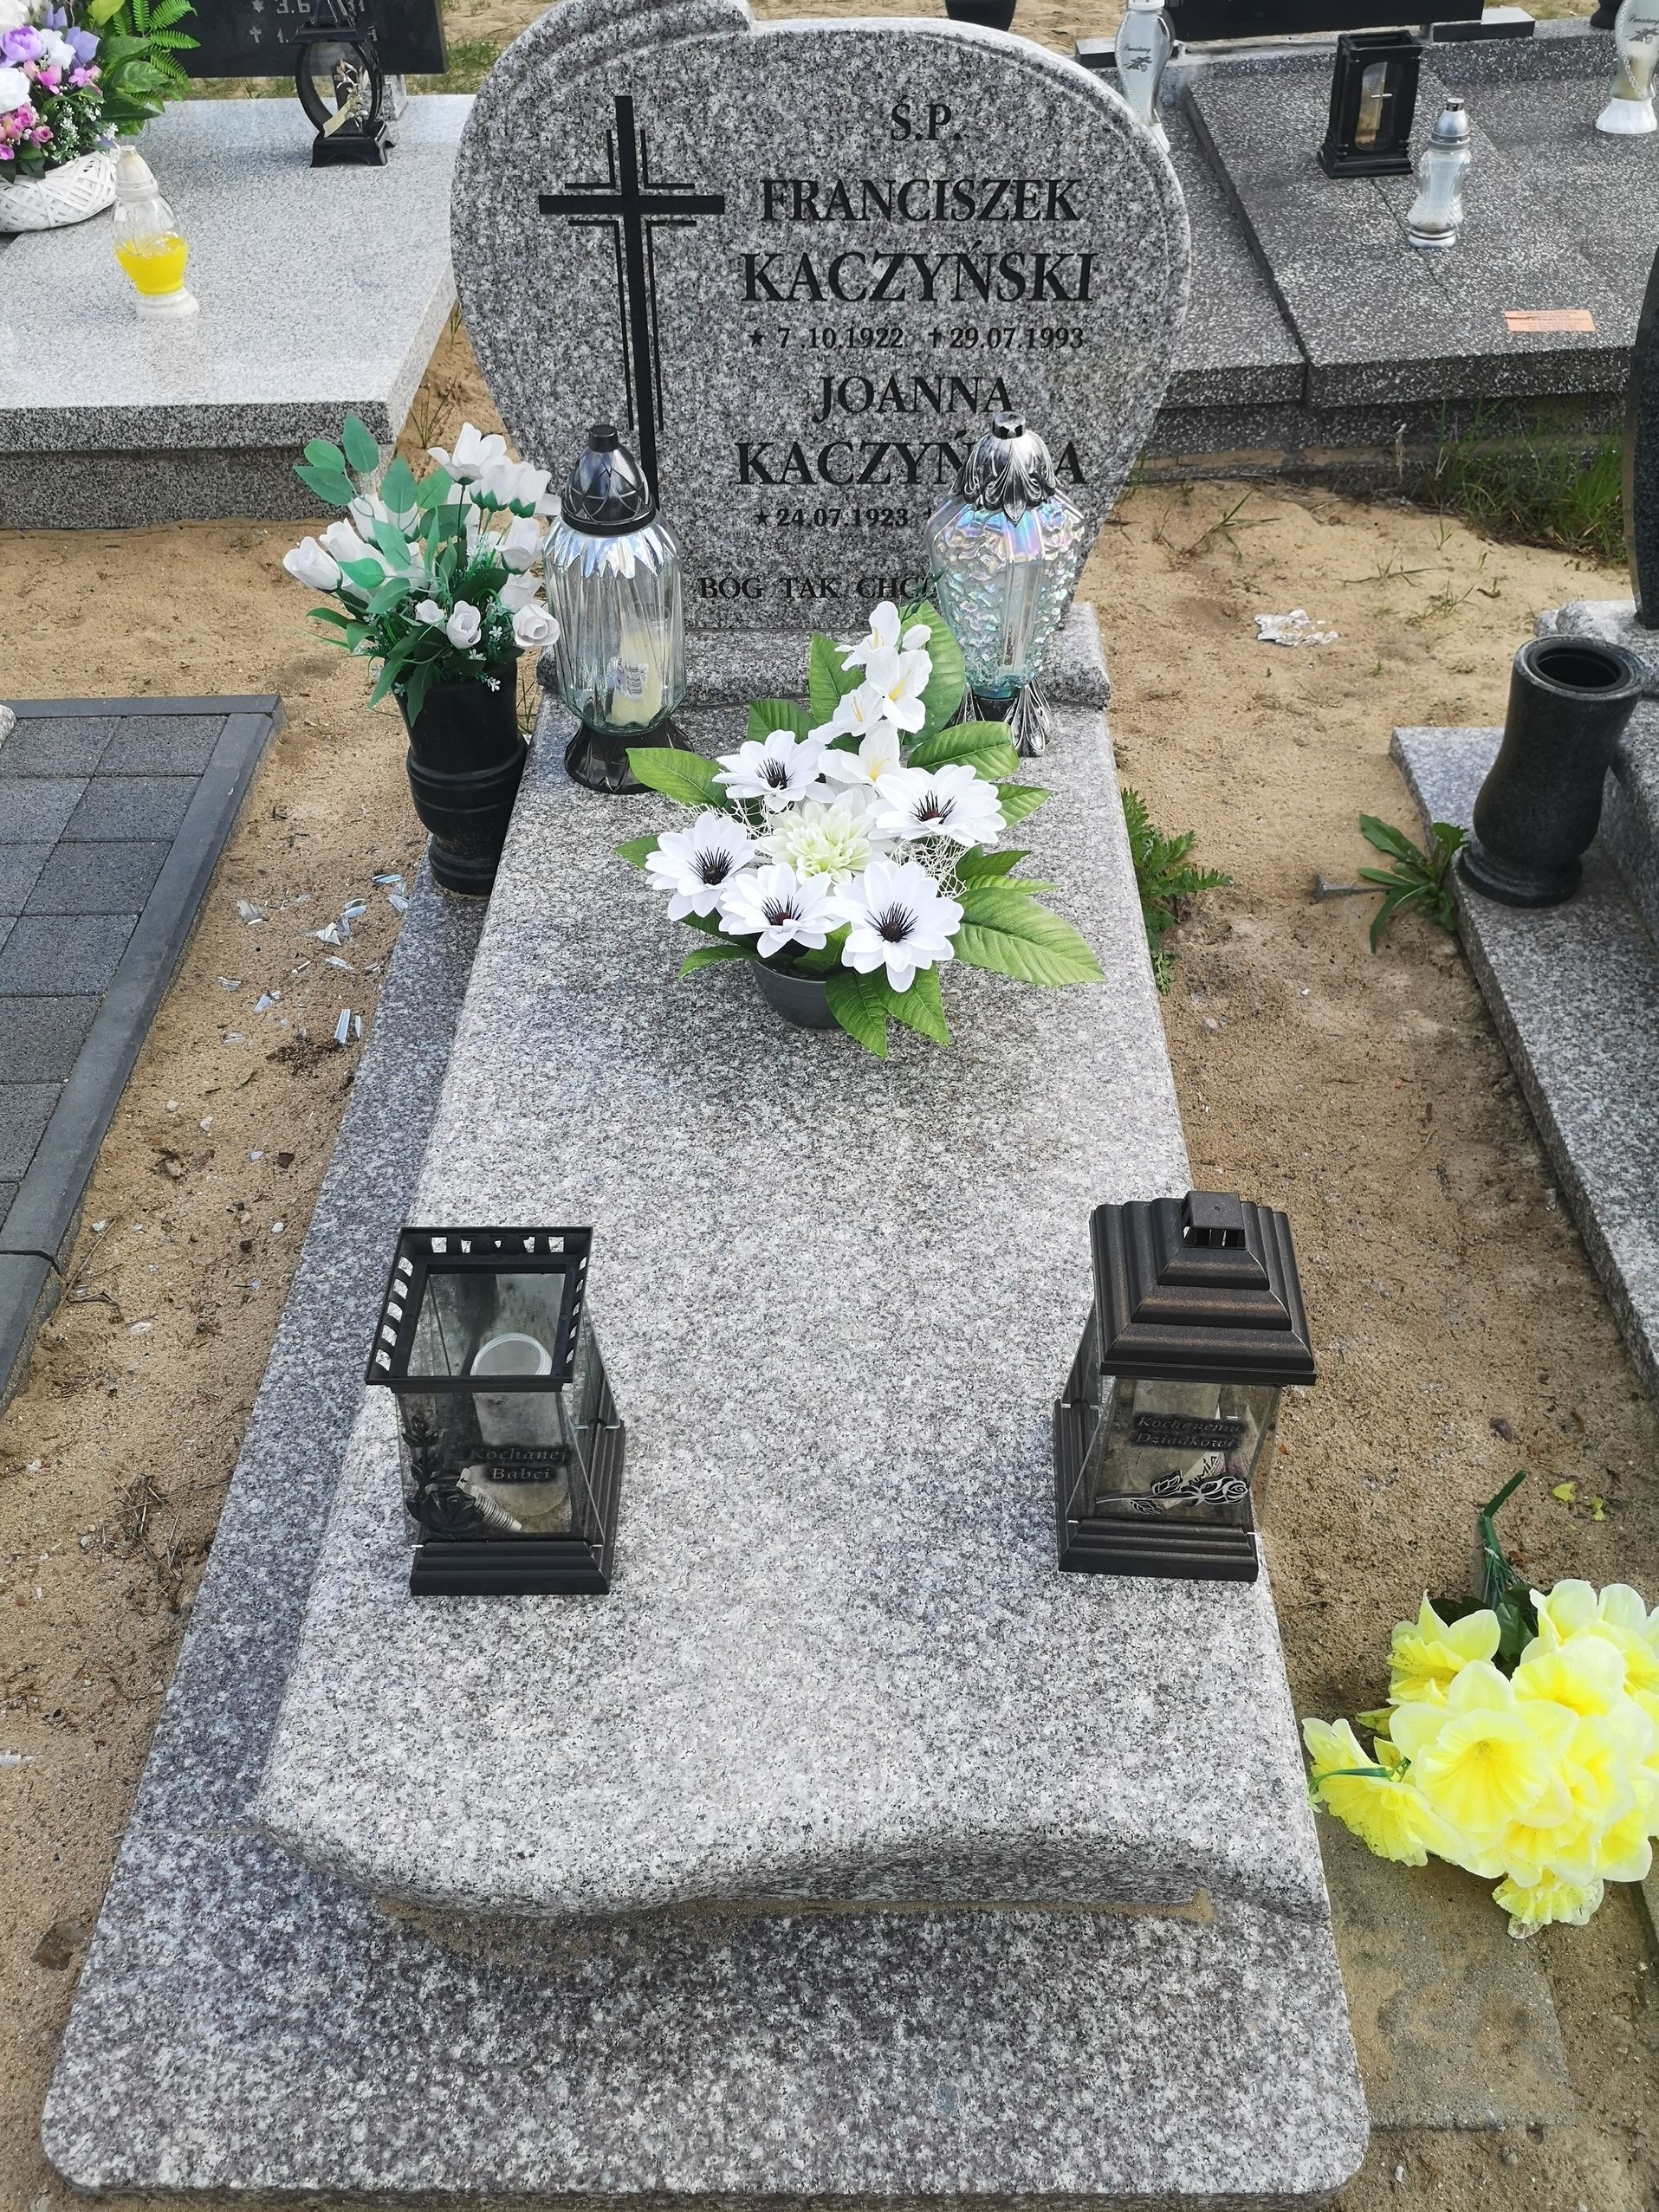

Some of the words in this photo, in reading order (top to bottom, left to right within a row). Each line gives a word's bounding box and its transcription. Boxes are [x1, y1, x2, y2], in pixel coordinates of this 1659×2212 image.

[891, 95, 961, 141] Ś.P.
[760, 178, 1081, 222] FRANCISZEK
[740, 240, 1099, 303] KACZYŃSKI
[952, 327, 1084, 349] 29.07.1993
[812, 374, 1014, 424] JOANNA
[734, 430, 1089, 486] KACZYŃA
[778, 508, 908, 527] 24.07.1923
[698, 571, 763, 599] BÓG
[780, 577, 840, 598] TAK
[1136, 1433, 1235, 1448] Dziadkowi
[470, 1448, 567, 1465] Kochanej
[491, 1468, 551, 1479] Babci
